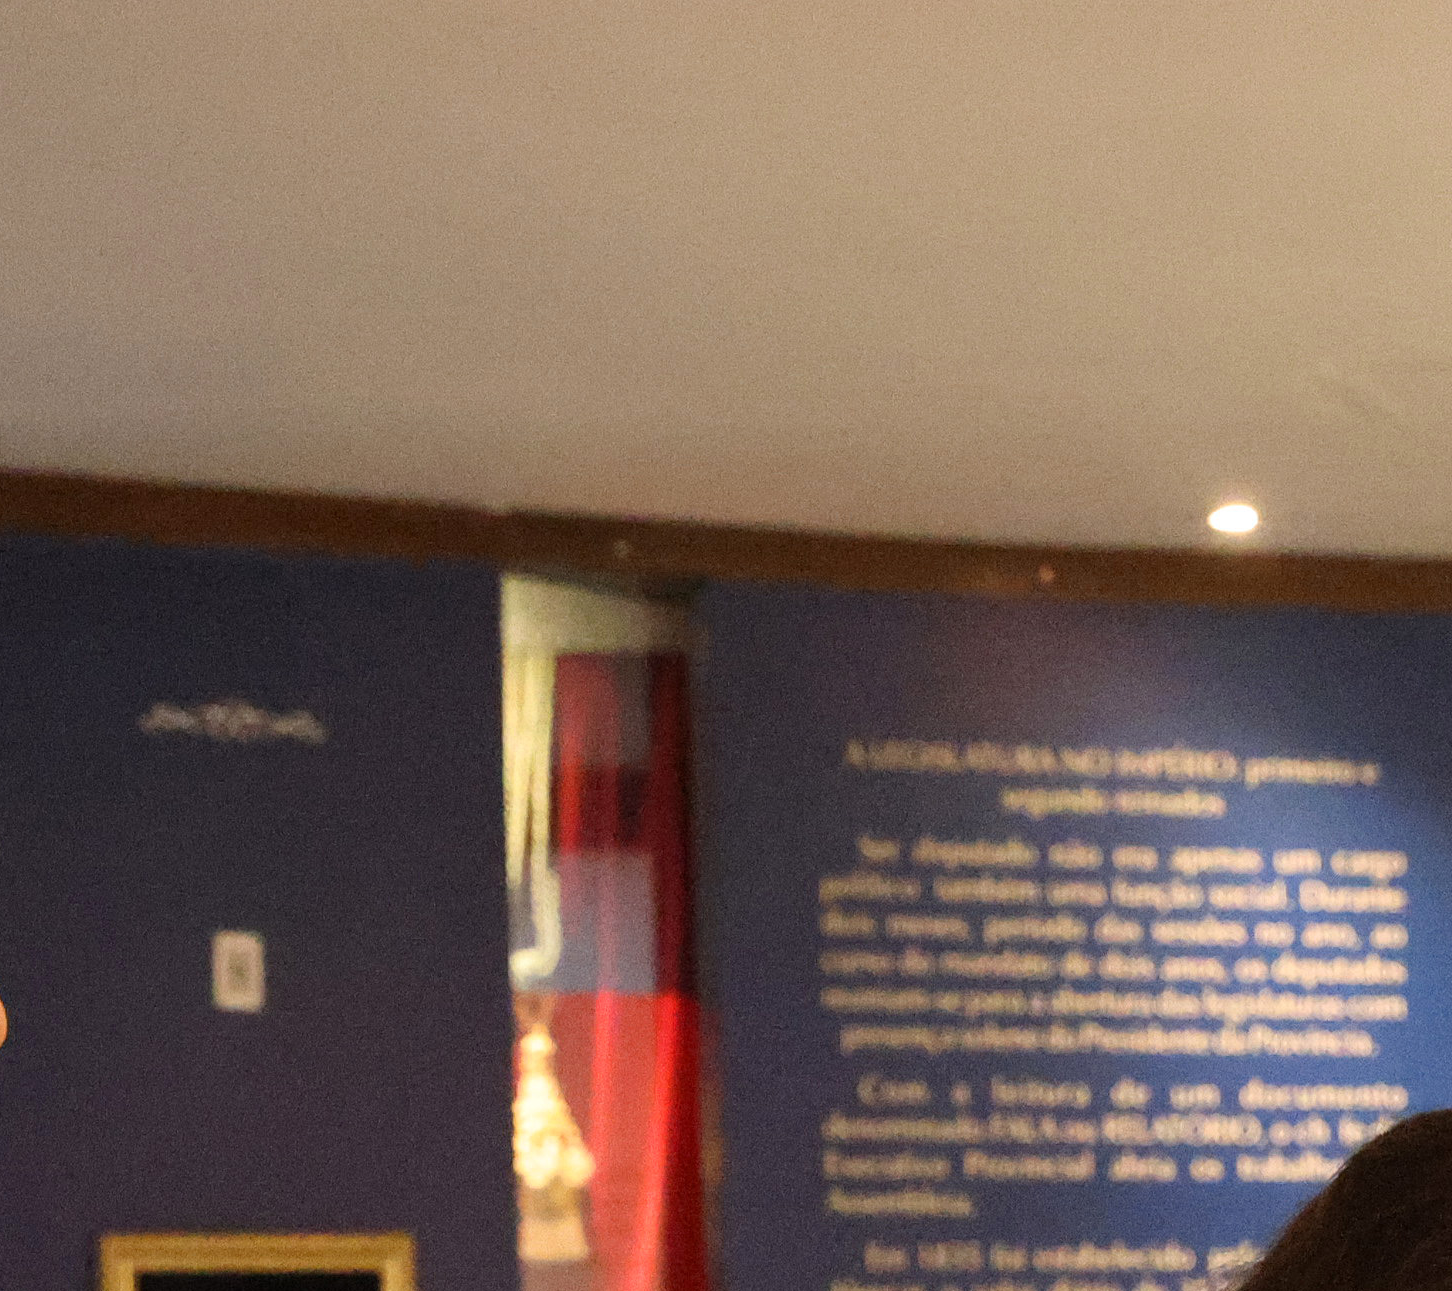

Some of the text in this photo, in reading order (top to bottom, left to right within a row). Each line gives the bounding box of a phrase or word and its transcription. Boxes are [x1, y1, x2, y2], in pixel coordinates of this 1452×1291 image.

[1271, 846, 1323, 877] um
[1329, 848, 1409, 883] cargo
[1168, 1082, 1221, 1110] um
[1238, 1077, 1409, 1111] documento
